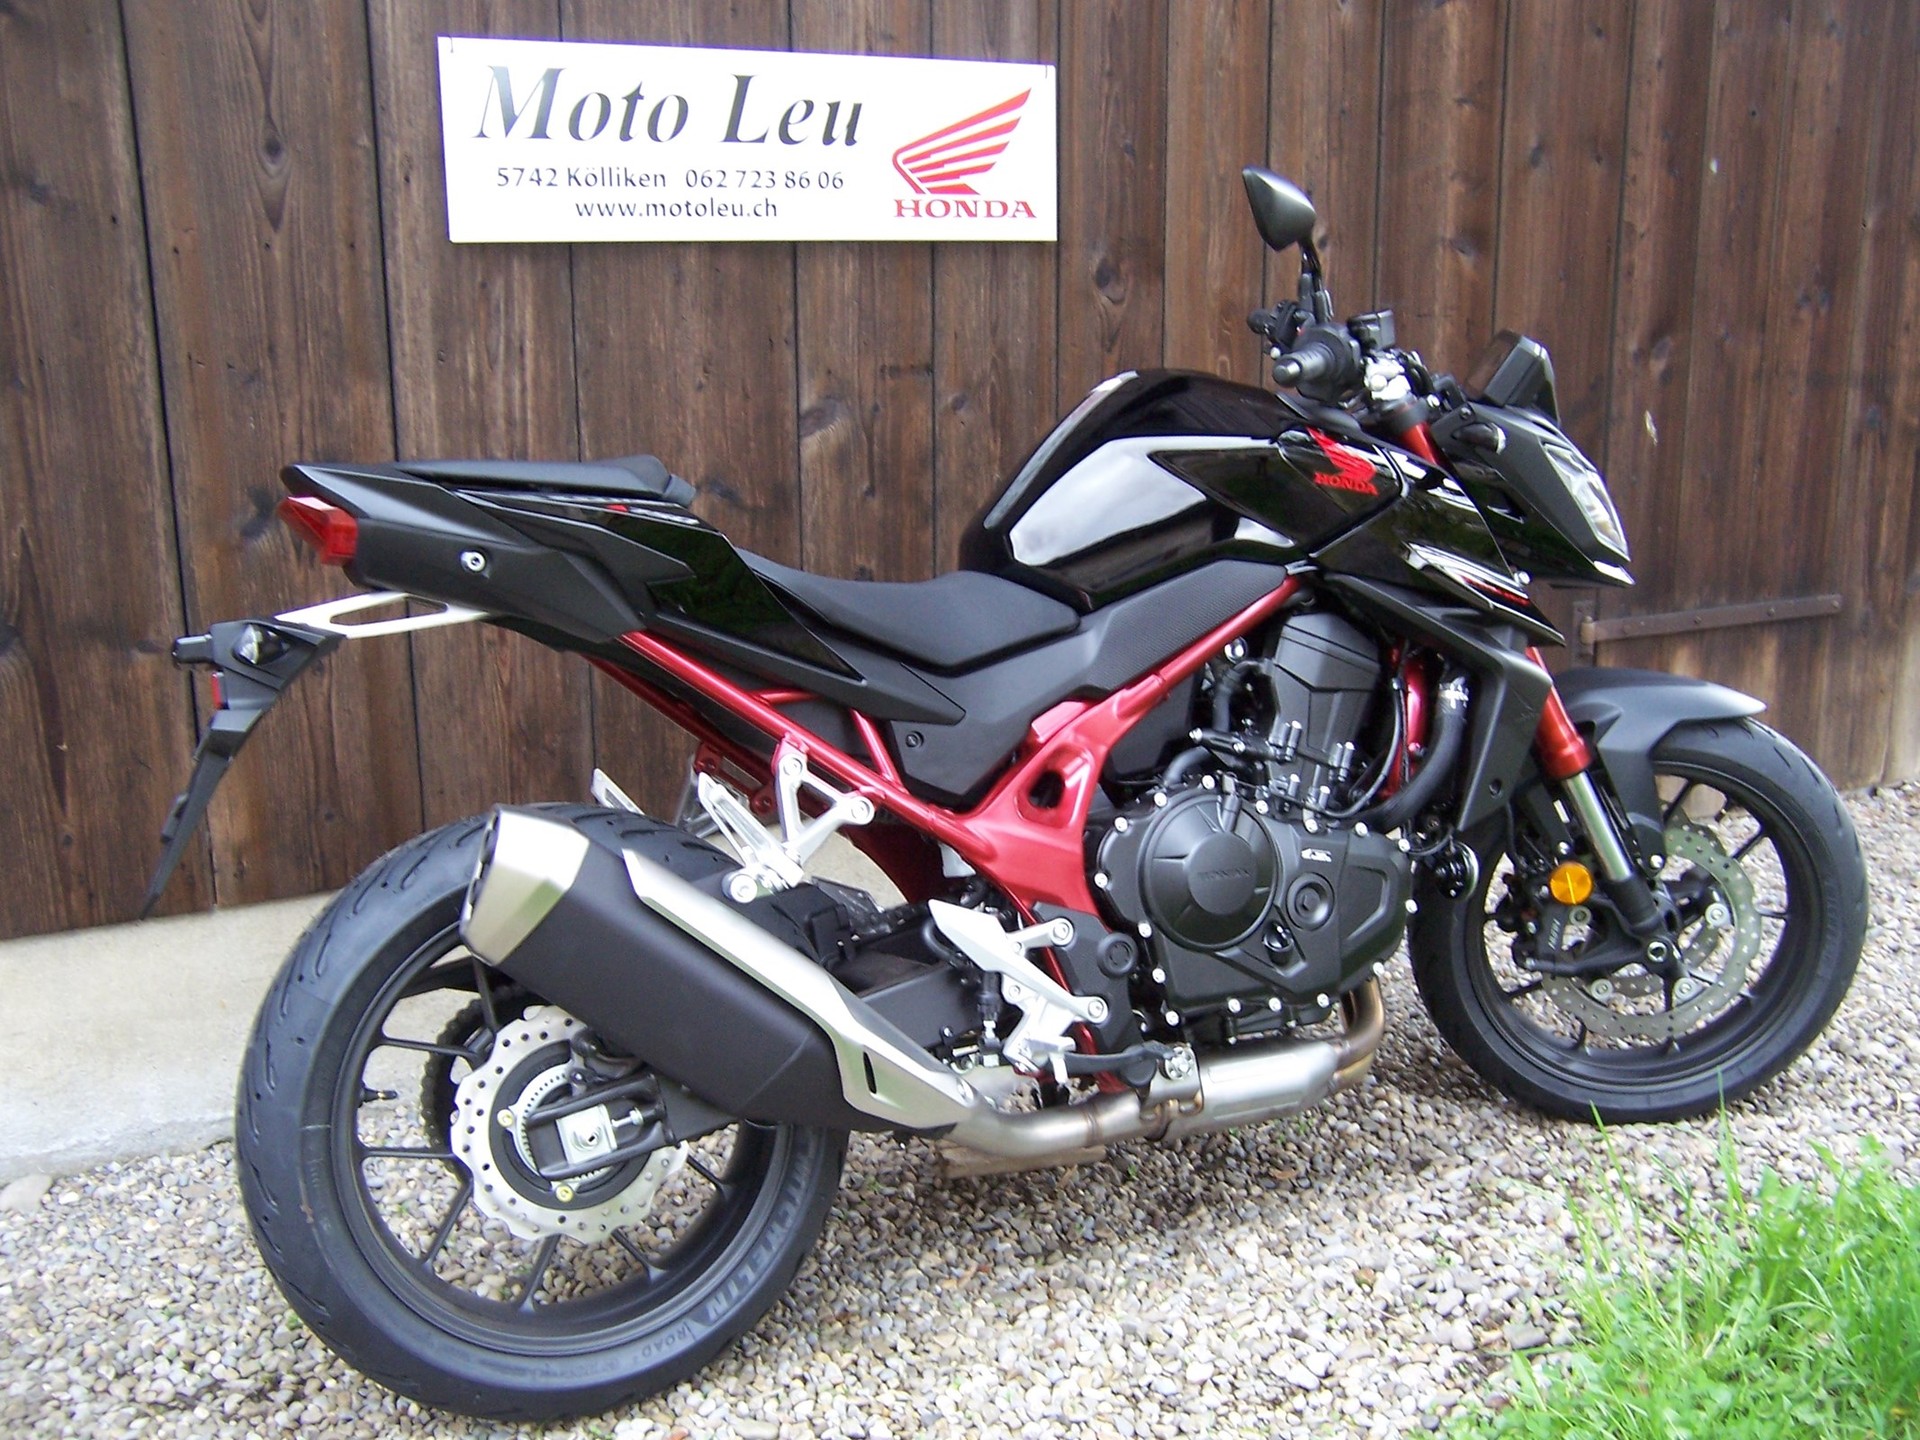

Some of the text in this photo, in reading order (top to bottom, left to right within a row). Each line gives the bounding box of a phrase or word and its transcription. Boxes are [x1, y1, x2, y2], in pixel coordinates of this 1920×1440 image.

[472, 66, 863, 146] Moto Leu
[497, 166, 844, 190] 5742 Kölliken 062 723 86 06
[575, 196, 778, 218] www.motoleu.ch
[894, 198, 1037, 219] HONDA
[1313, 471, 1380, 496] HONDA
